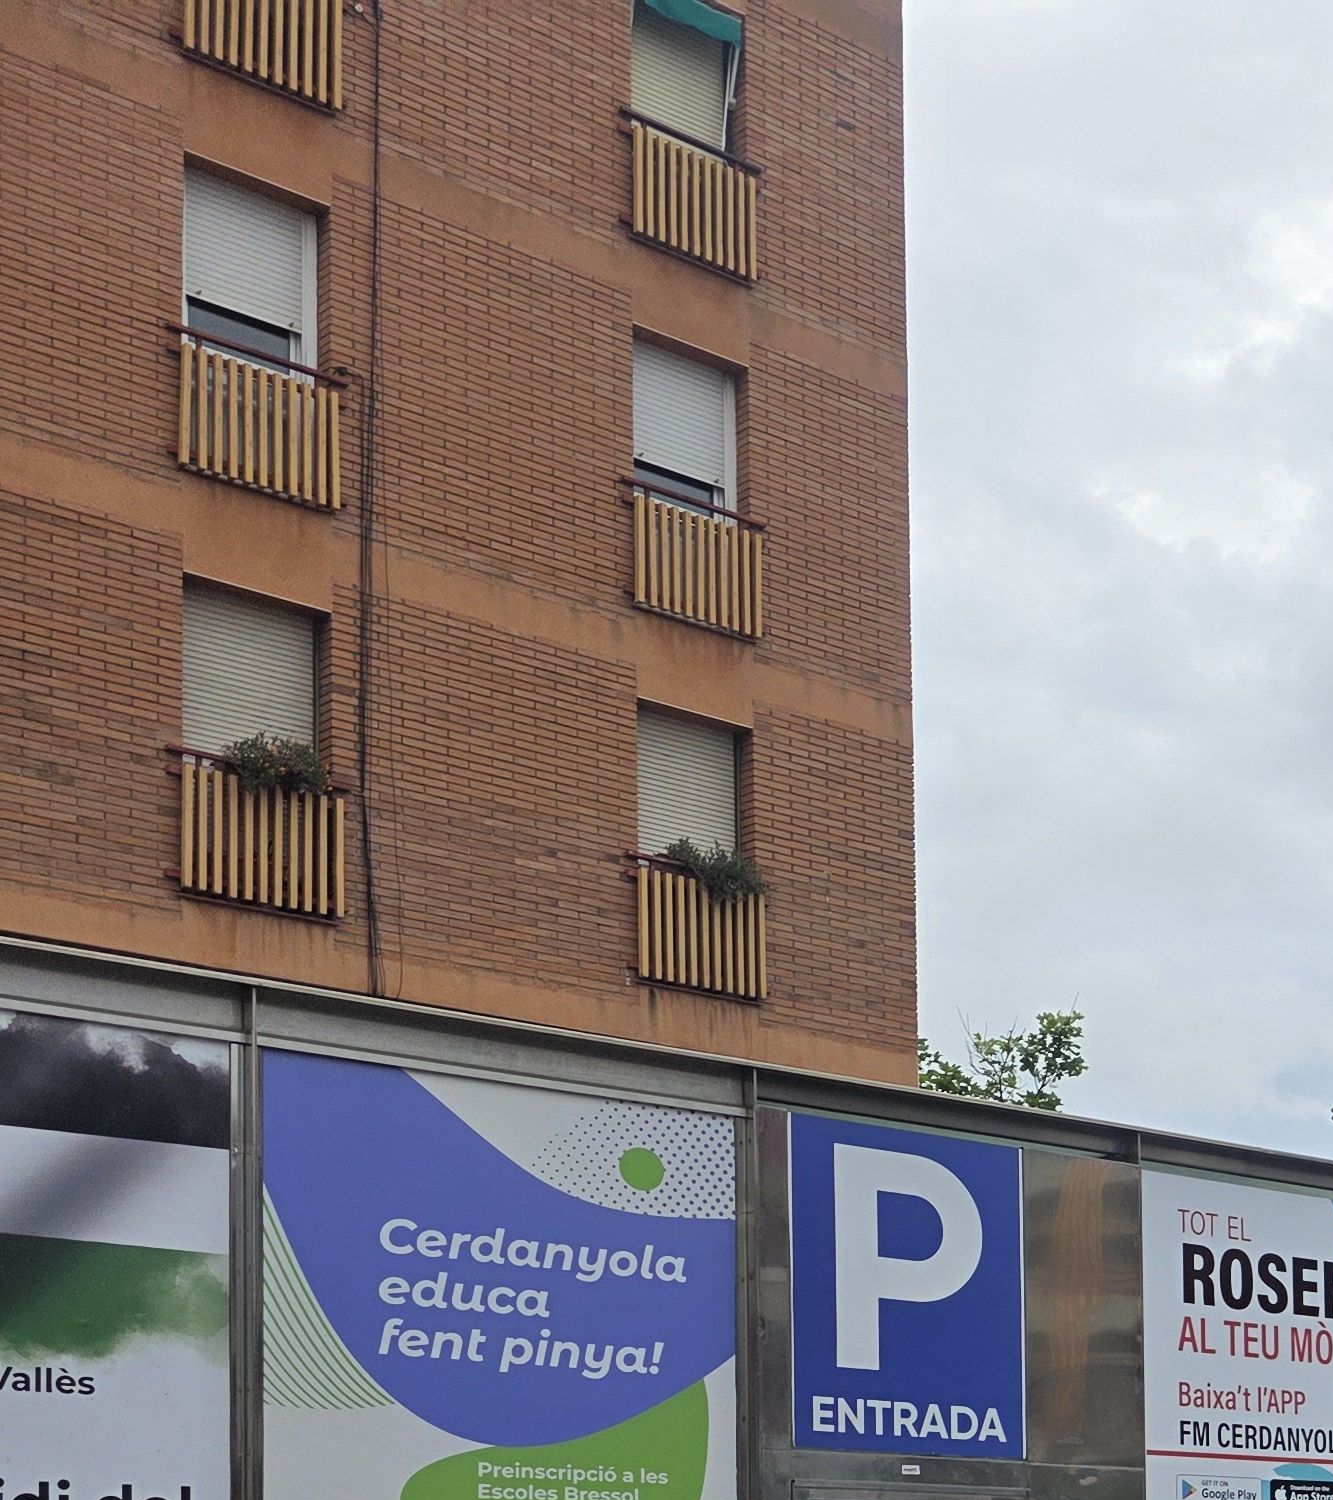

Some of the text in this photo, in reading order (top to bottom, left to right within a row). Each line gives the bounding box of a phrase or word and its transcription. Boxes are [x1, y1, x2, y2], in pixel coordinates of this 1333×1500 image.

[1177, 1209, 1252, 1241] TOT EL
[379, 1218, 687, 1283] Cerdanyola
[834, 1143, 983, 1370] P
[378, 1272, 550, 1318] educa
[378, 1318, 664, 1380] fent pinya!
[1178, 1316, 1216, 1354] AL
[1224, 1320, 1279, 1360] TEU
[812, 1395, 1007, 1443] ENTRADA
[1180, 1420, 1210, 1447] FM
[478, 1462, 669, 1485] Preinscripció a les
[478, 1484, 558, 1500] Escoles
[1201, 1488, 1235, 1500] Google
